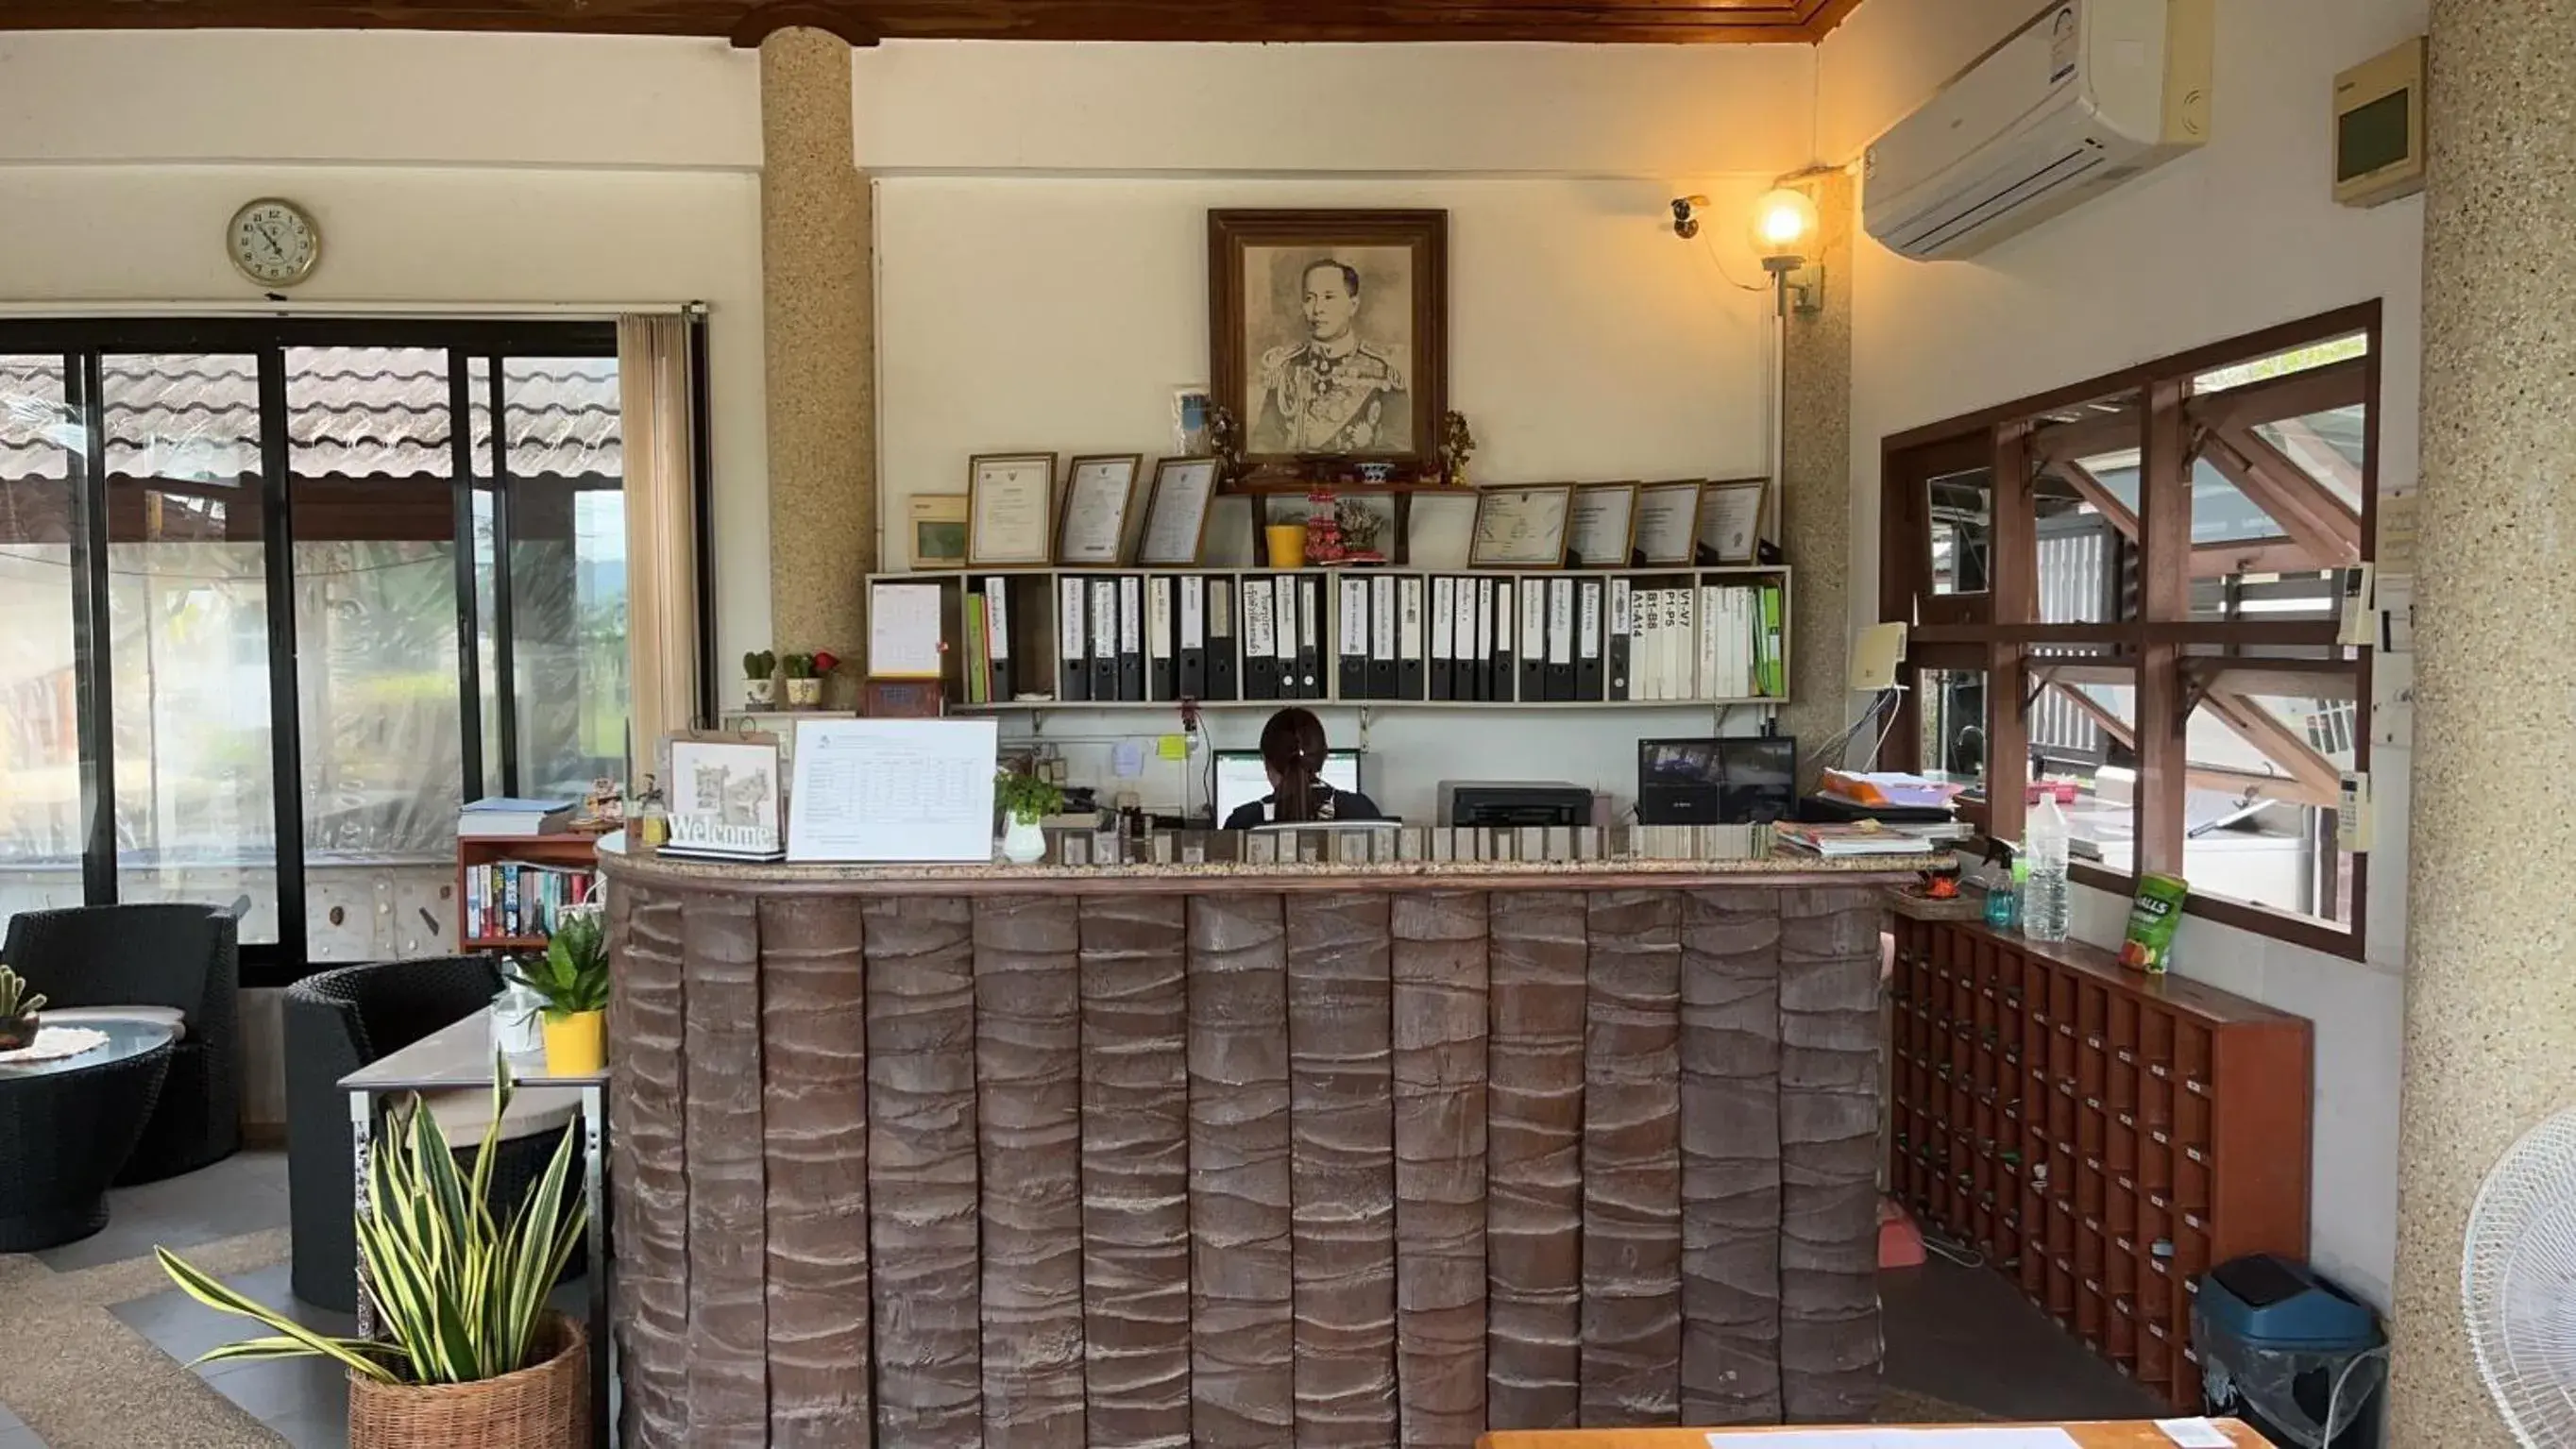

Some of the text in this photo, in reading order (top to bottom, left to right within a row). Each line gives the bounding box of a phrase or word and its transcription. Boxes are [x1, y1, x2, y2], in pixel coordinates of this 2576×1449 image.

[268, 209, 280, 219] 12
[1633, 593, 1643, 638] A1-A14
[1679, 591, 1690, 628] V1-V7
[667, 813, 771, 847] Welcome
